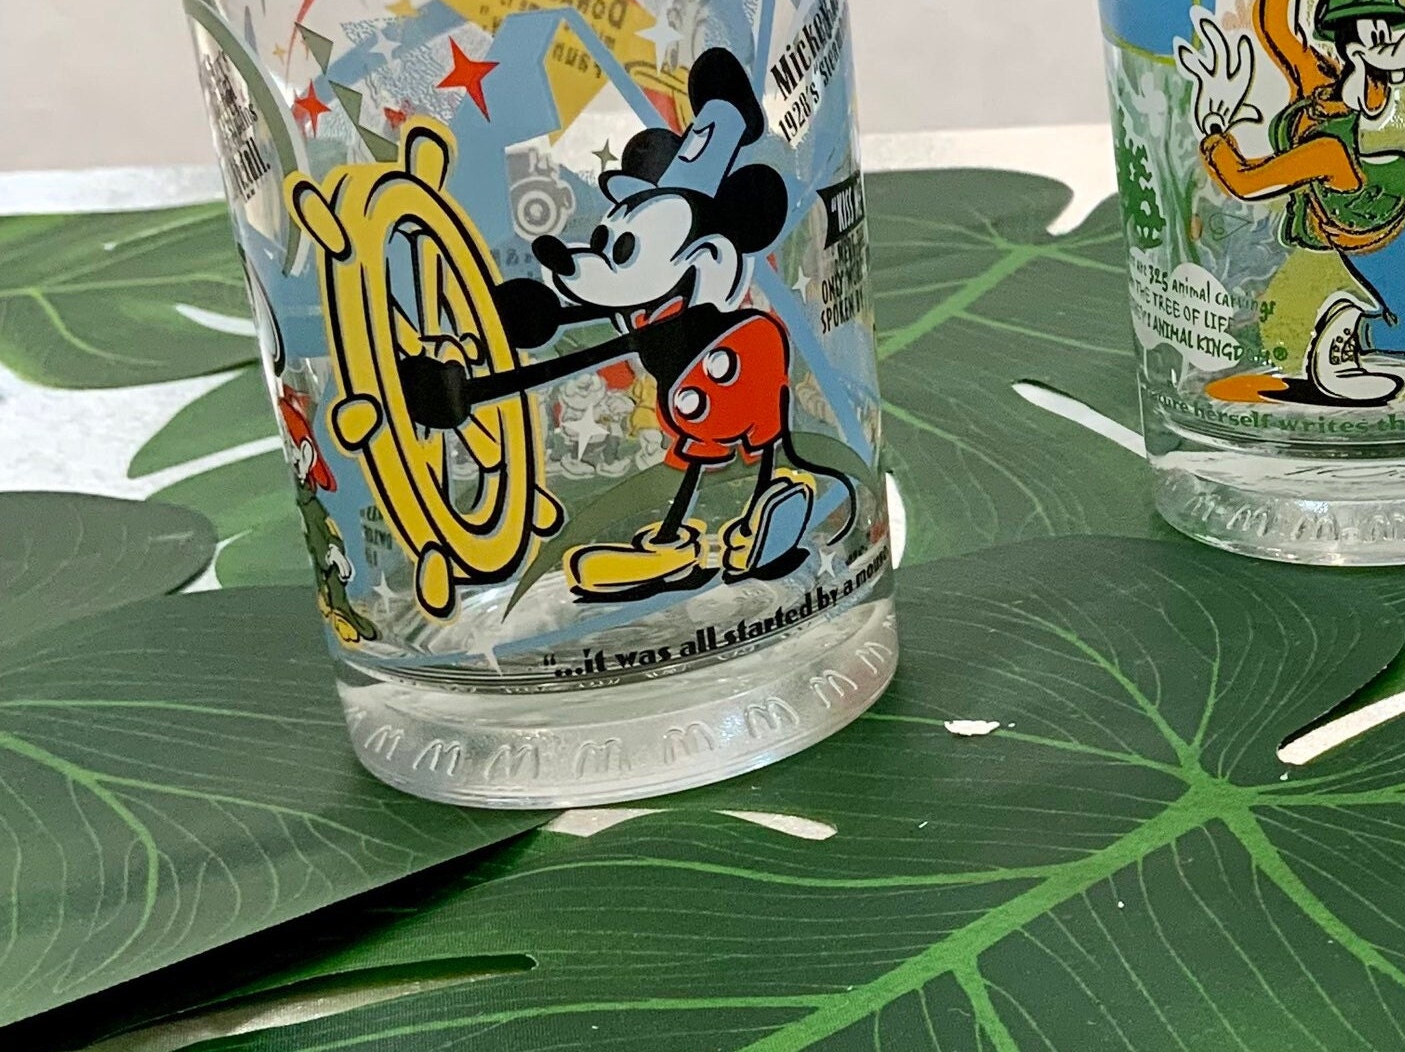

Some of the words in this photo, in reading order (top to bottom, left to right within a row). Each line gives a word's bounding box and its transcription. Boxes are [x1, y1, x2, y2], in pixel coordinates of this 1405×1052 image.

[1152, 291, 1181, 318] TREE
[1183, 305, 1201, 326] OF
[1152, 315, 1194, 349] ANIMAL
[1194, 402, 1272, 430] herself
[1279, 415, 1369, 434] writes
[615, 646, 672, 670] was
[680, 625, 717, 659] all
[723, 589, 813, 645] started
[815, 585, 839, 616] by
[843, 578, 854, 597] a
